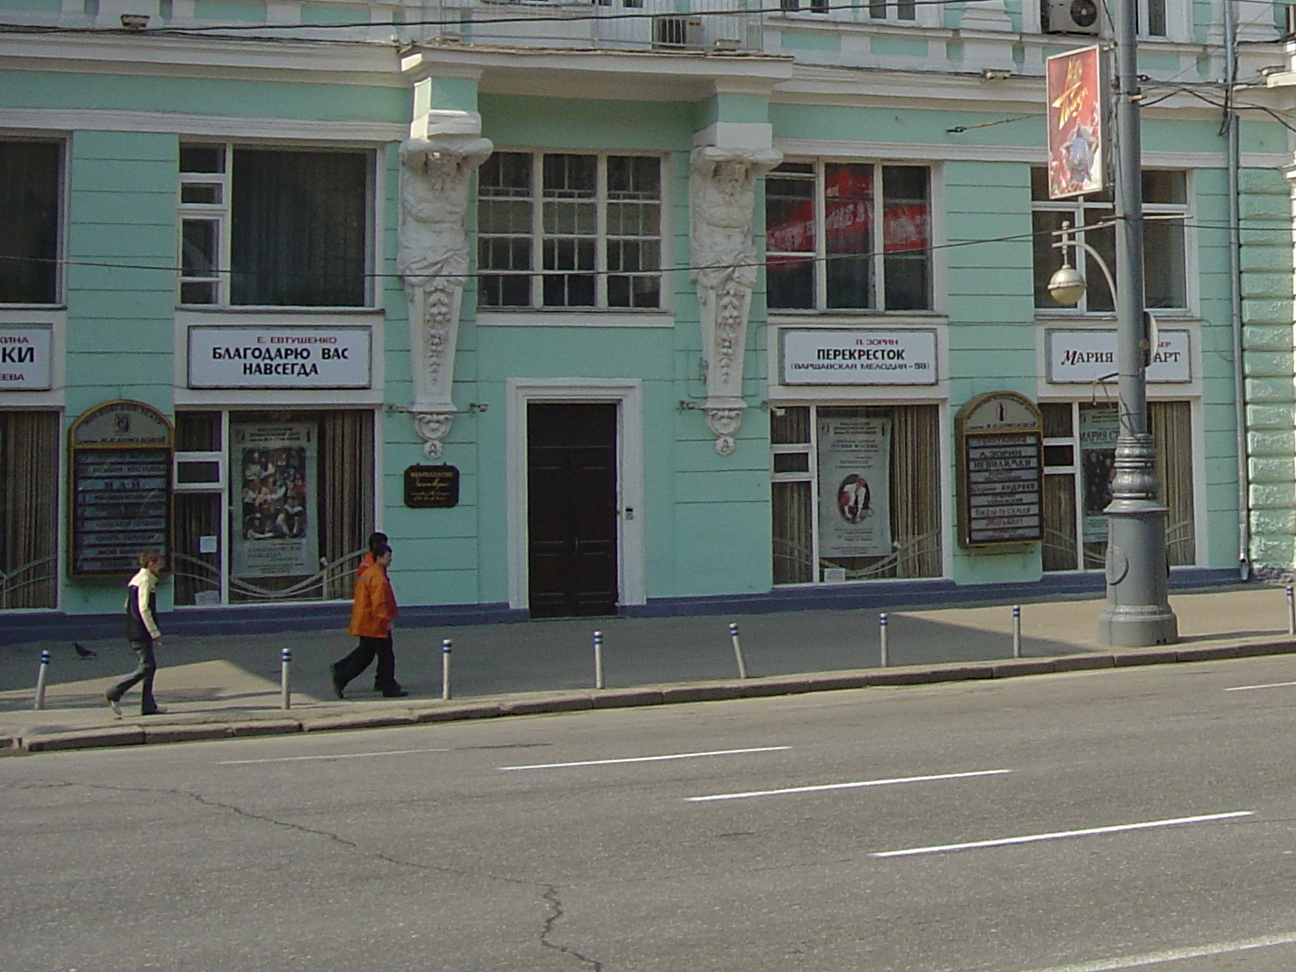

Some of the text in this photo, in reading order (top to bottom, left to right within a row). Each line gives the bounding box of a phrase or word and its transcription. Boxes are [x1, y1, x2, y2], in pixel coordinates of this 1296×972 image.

[270, 336, 338, 344] ЕВТУШЕНКО
[866, 338, 899, 346] ЗОРИН
[212, 347, 349, 361] БЛАГОДАРЮ ВАС
[816, 348, 906, 361] ПЕРЕКРЕСТОК
[1060, 349, 1181, 366] МАРИЯ АРТ
[243, 362, 319, 376] НАВСЕГДА
